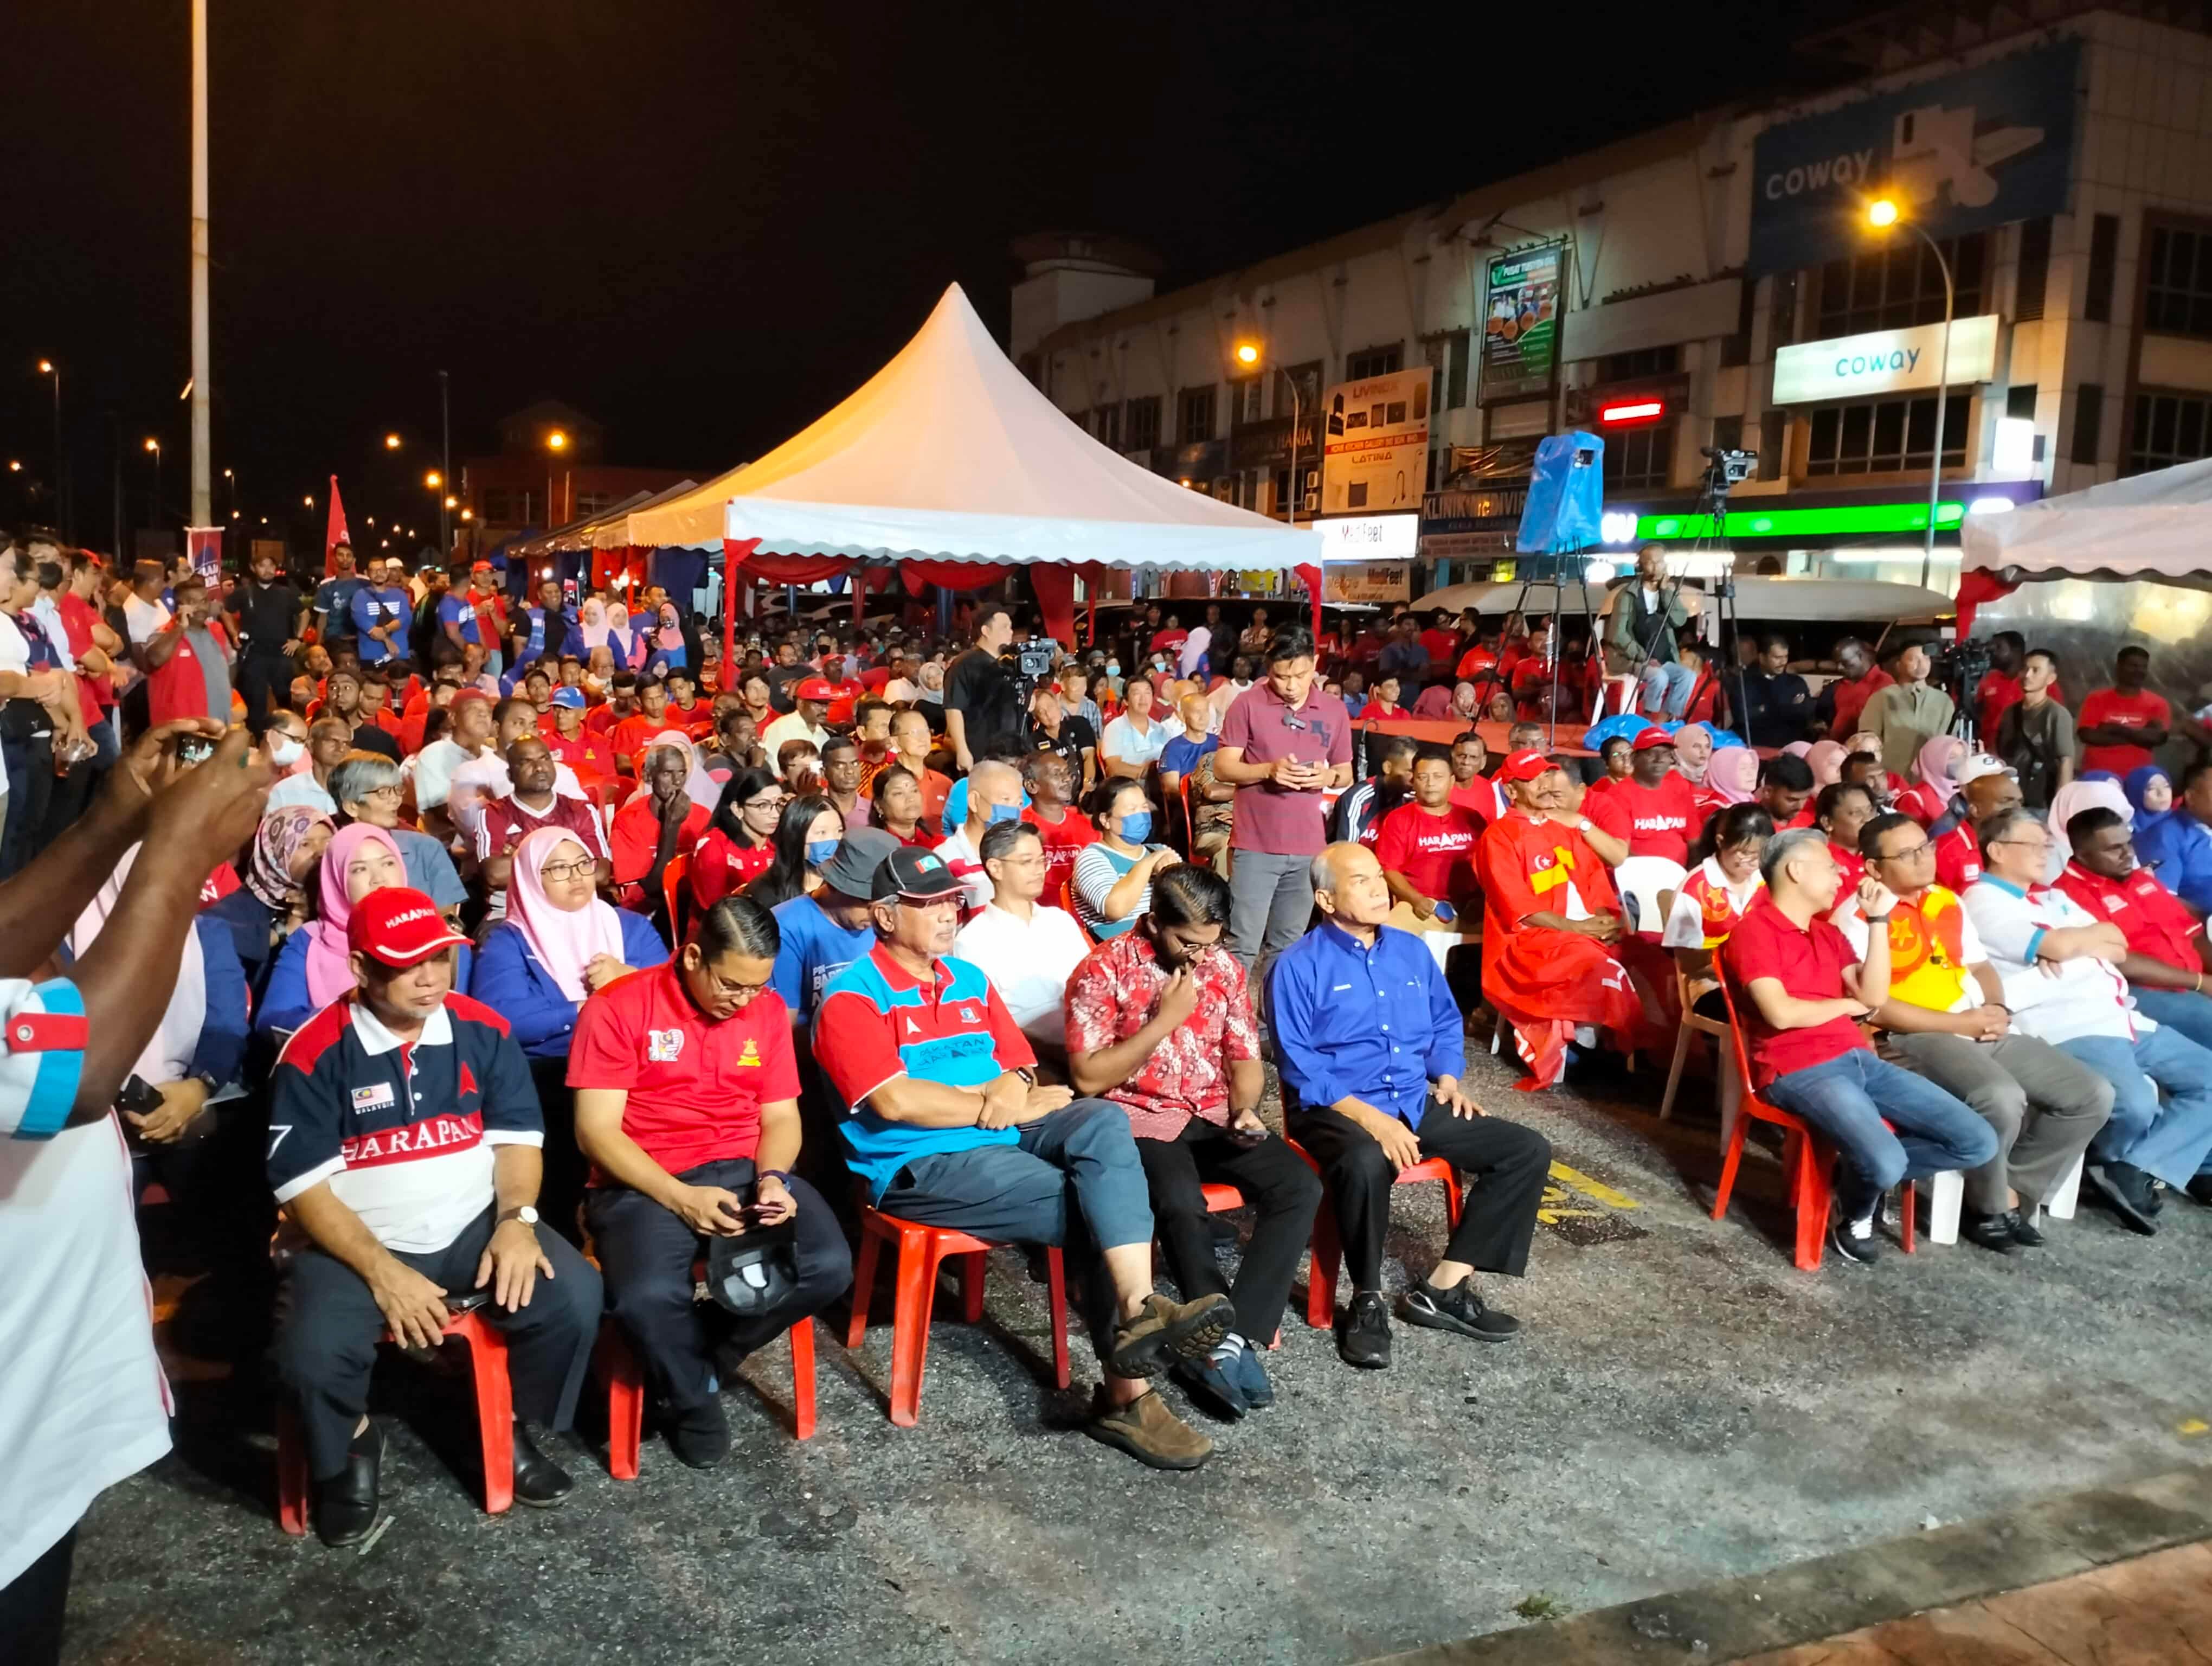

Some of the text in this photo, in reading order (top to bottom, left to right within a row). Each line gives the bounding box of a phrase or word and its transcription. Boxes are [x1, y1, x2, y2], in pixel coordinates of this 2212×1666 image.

[1765, 148, 1874, 200] coway
[1836, 347, 1921, 376] coway
[1352, 452, 1392, 464] LATINA
[1423, 495, 1466, 520] KLINIK
[1634, 814, 1687, 831] HARAPAN
[1419, 832, 1472, 847] HARAPAN
[384, 908, 436, 929] HARAPAN
